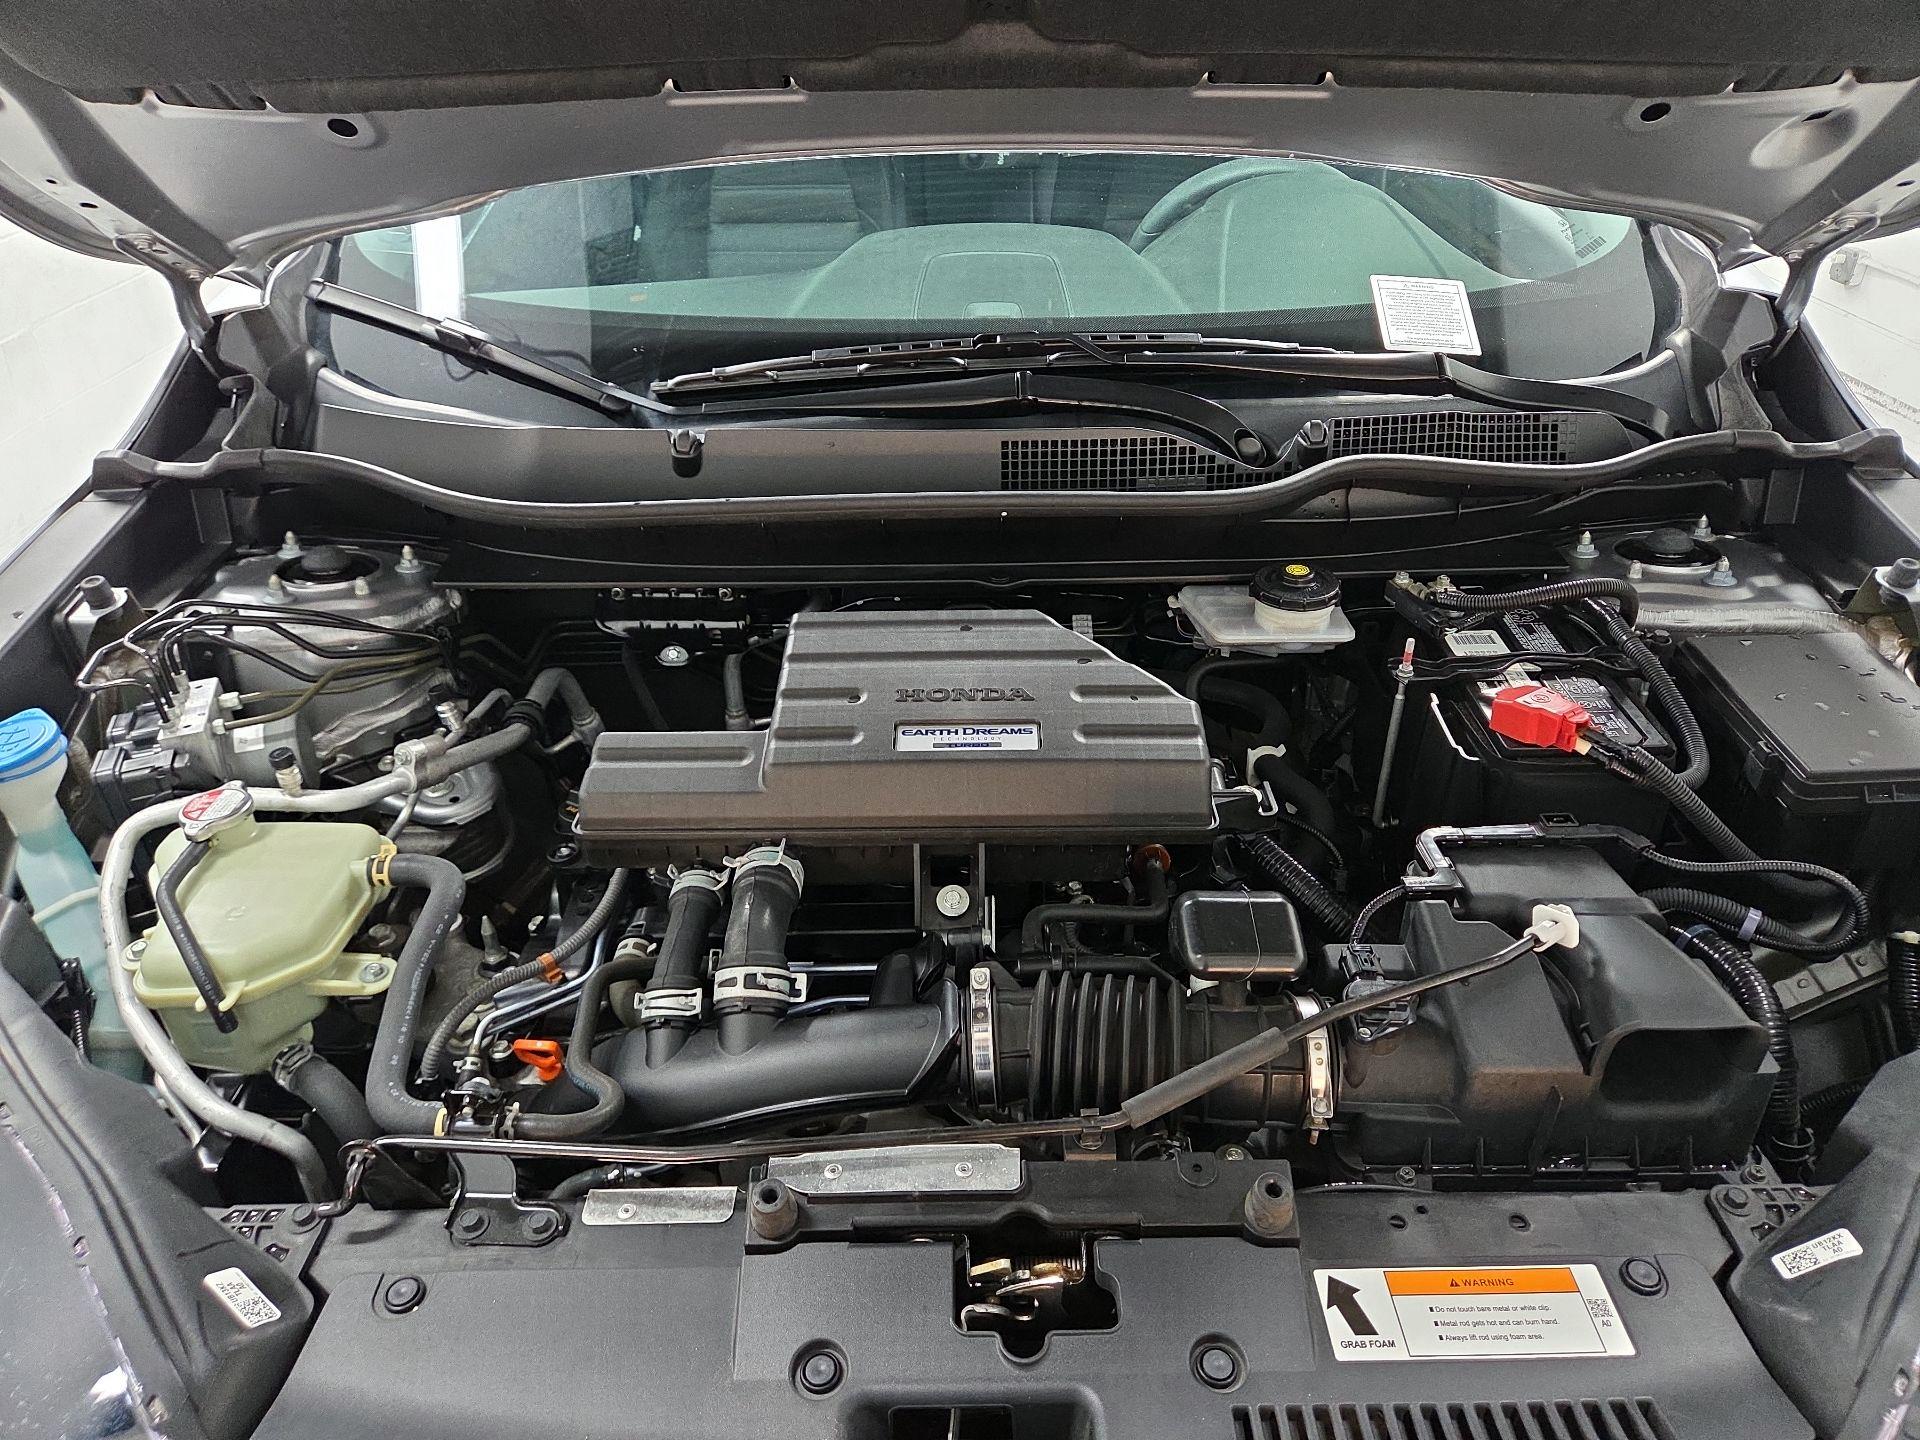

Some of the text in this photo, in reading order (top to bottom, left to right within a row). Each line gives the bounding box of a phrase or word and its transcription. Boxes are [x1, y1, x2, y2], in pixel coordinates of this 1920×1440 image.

[895, 687, 1035, 702] HONDA
[962, 727, 1034, 736] DREAMS
[1822, 1240, 1844, 1252] TLAA
[1462, 1277, 1514, 1288] WARNING
[1490, 1334, 1509, 1342] using
[1340, 1340, 1396, 1348] GRAB FOAM
